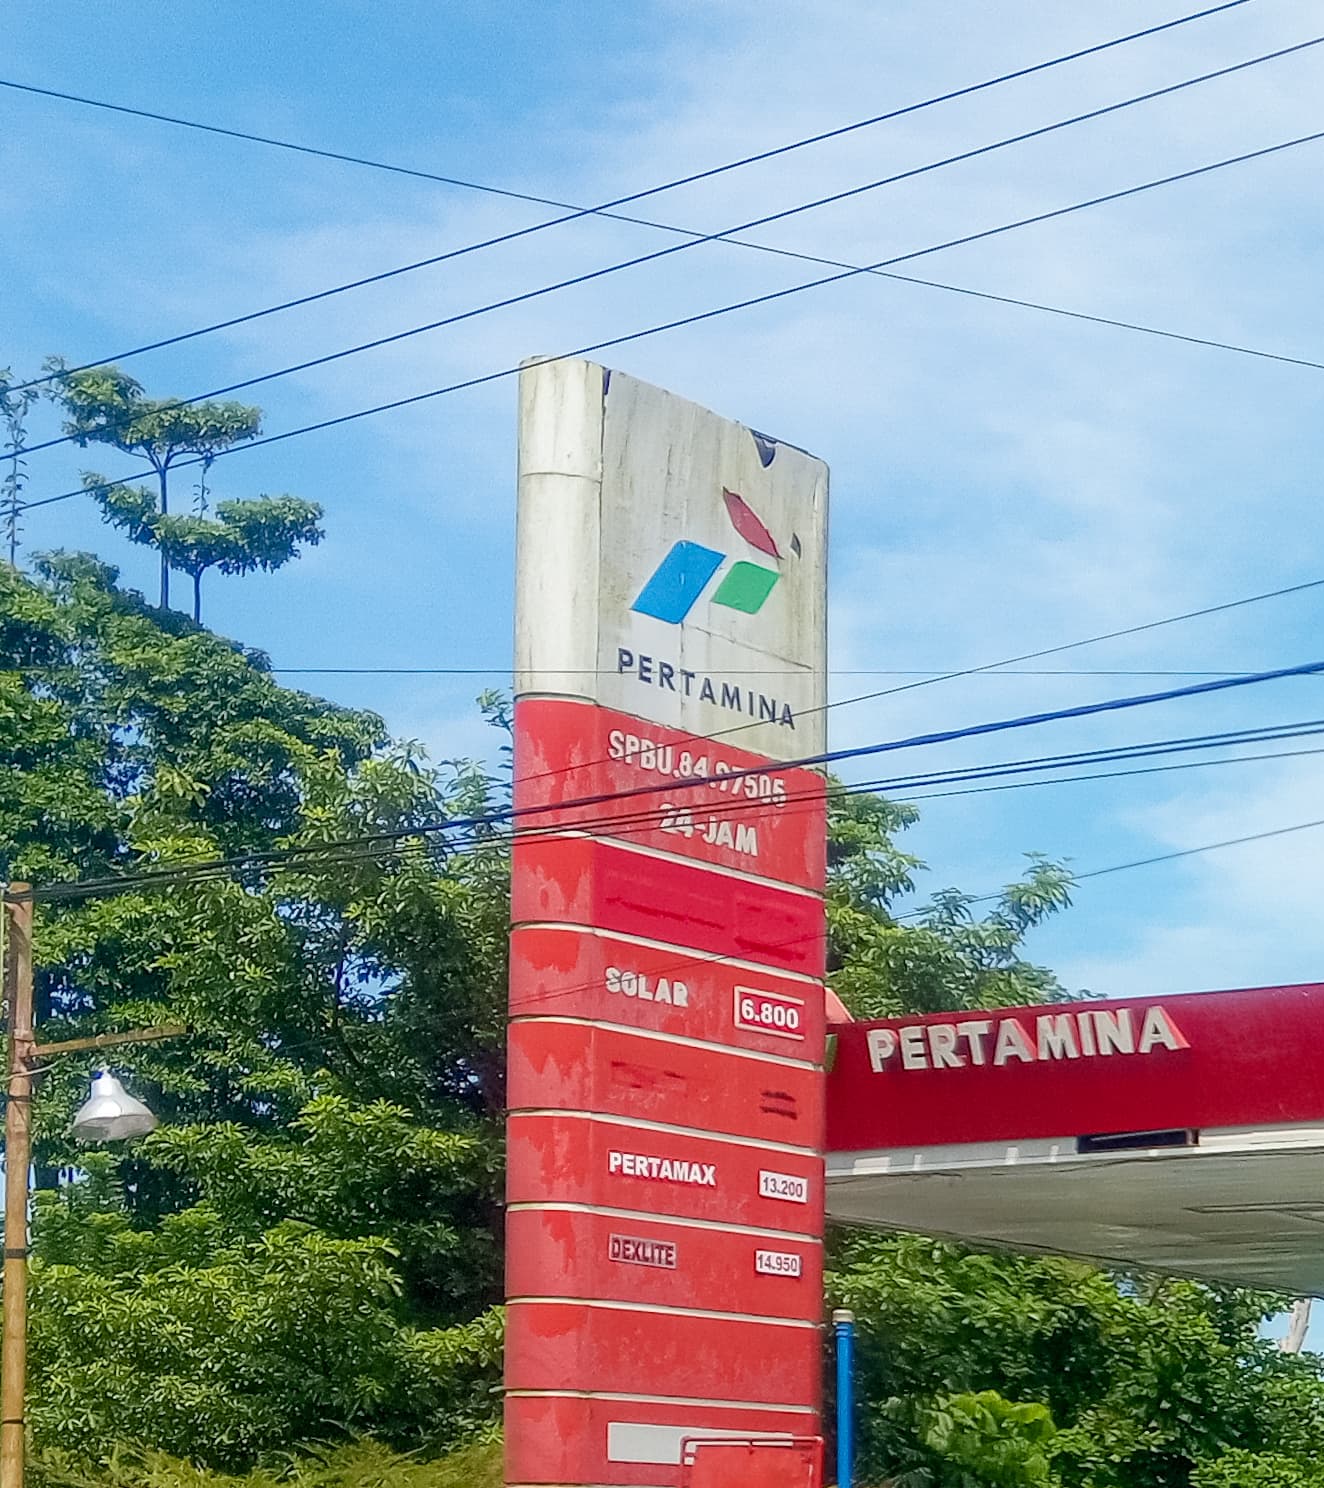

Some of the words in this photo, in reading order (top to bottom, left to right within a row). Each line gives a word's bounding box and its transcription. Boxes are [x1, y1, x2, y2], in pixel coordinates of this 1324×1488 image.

[617, 647, 796, 731] PERTAMINA
[605, 966, 689, 1008] SOLAR
[741, 998, 799, 1030] 6.800
[866, 1005, 1191, 1073] PERTAMINA
[608, 1151, 717, 1186] PERTAMAX
[762, 1175, 804, 1199] 13.200
[611, 1236, 675, 1267] DEXLITE
[757, 1253, 798, 1273] 14.950
